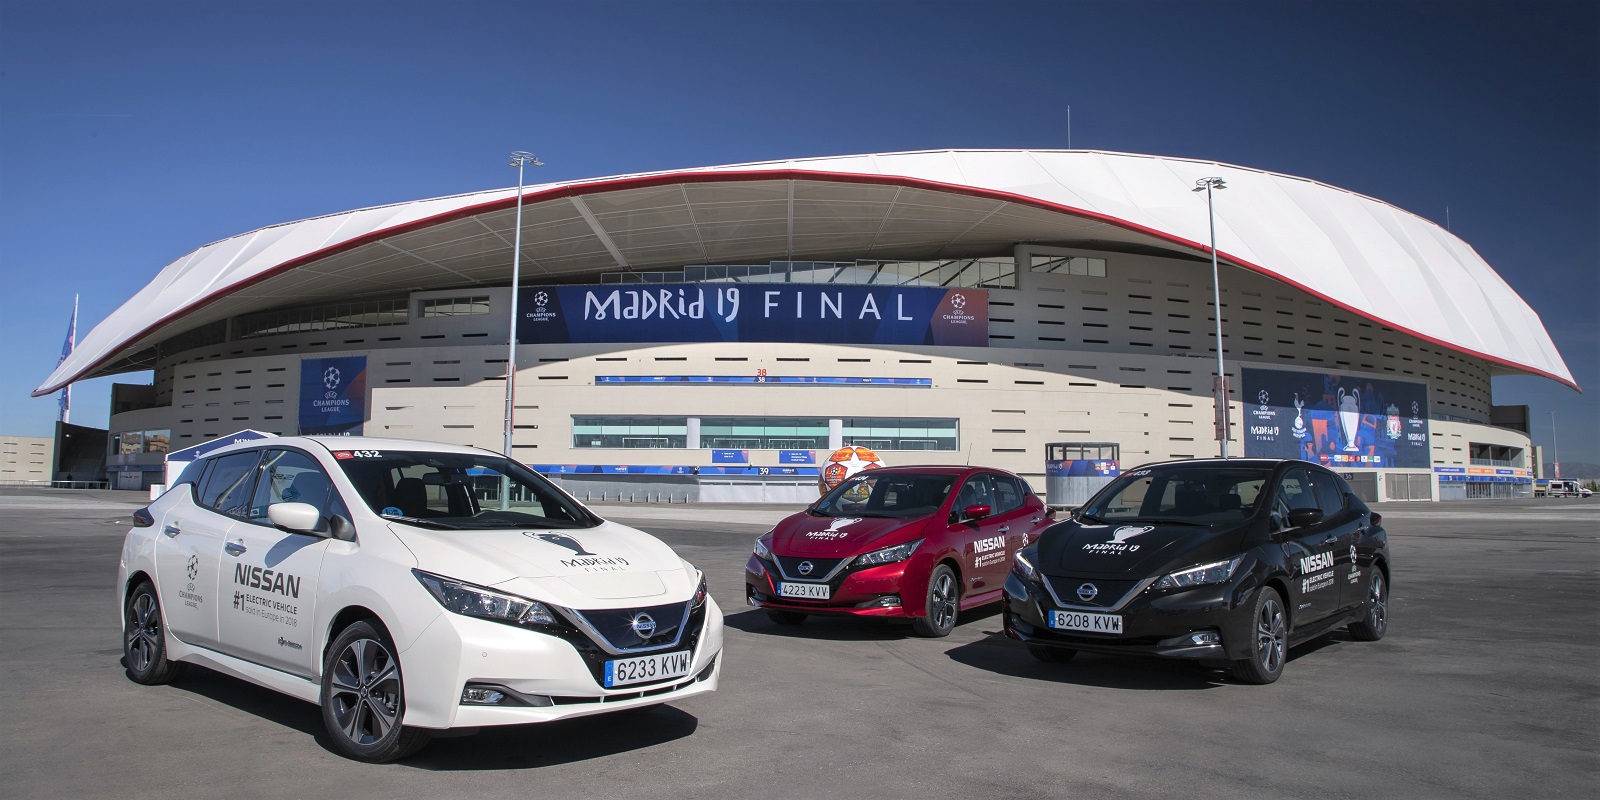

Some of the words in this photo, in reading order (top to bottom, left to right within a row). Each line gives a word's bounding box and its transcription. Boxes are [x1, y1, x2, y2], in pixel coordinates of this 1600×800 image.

[718, 288, 739, 322] 19
[765, 291, 913, 321] FINAL
[757, 368, 767, 377] 38
[313, 399, 350, 407] CHAMPIONS
[353, 450, 383, 458] 432
[759, 467, 770, 475] 39
[974, 536, 1005, 553] NISSAN
[1128, 544, 1141, 552] 19
[974, 556, 982, 568] #1
[1300, 551, 1334, 574] NISSAN
[234, 563, 301, 599] NISSAN
[1302, 578, 1310, 594] #1
[179, 590, 204, 603] CHAMPIONS
[783, 585, 806, 596] 4223
[809, 586, 827, 597] KVV
[233, 590, 245, 612] #1
[246, 594, 272, 608] ELECTRIC
[272, 600, 298, 615] VEHICLE
[261, 609, 279, 623] Europe
[285, 616, 298, 628] 2018
[1058, 613, 1090, 628] 6208
[1094, 616, 1119, 631] KVW
[617, 659, 656, 681] 6233
[661, 653, 688, 676] KVW
